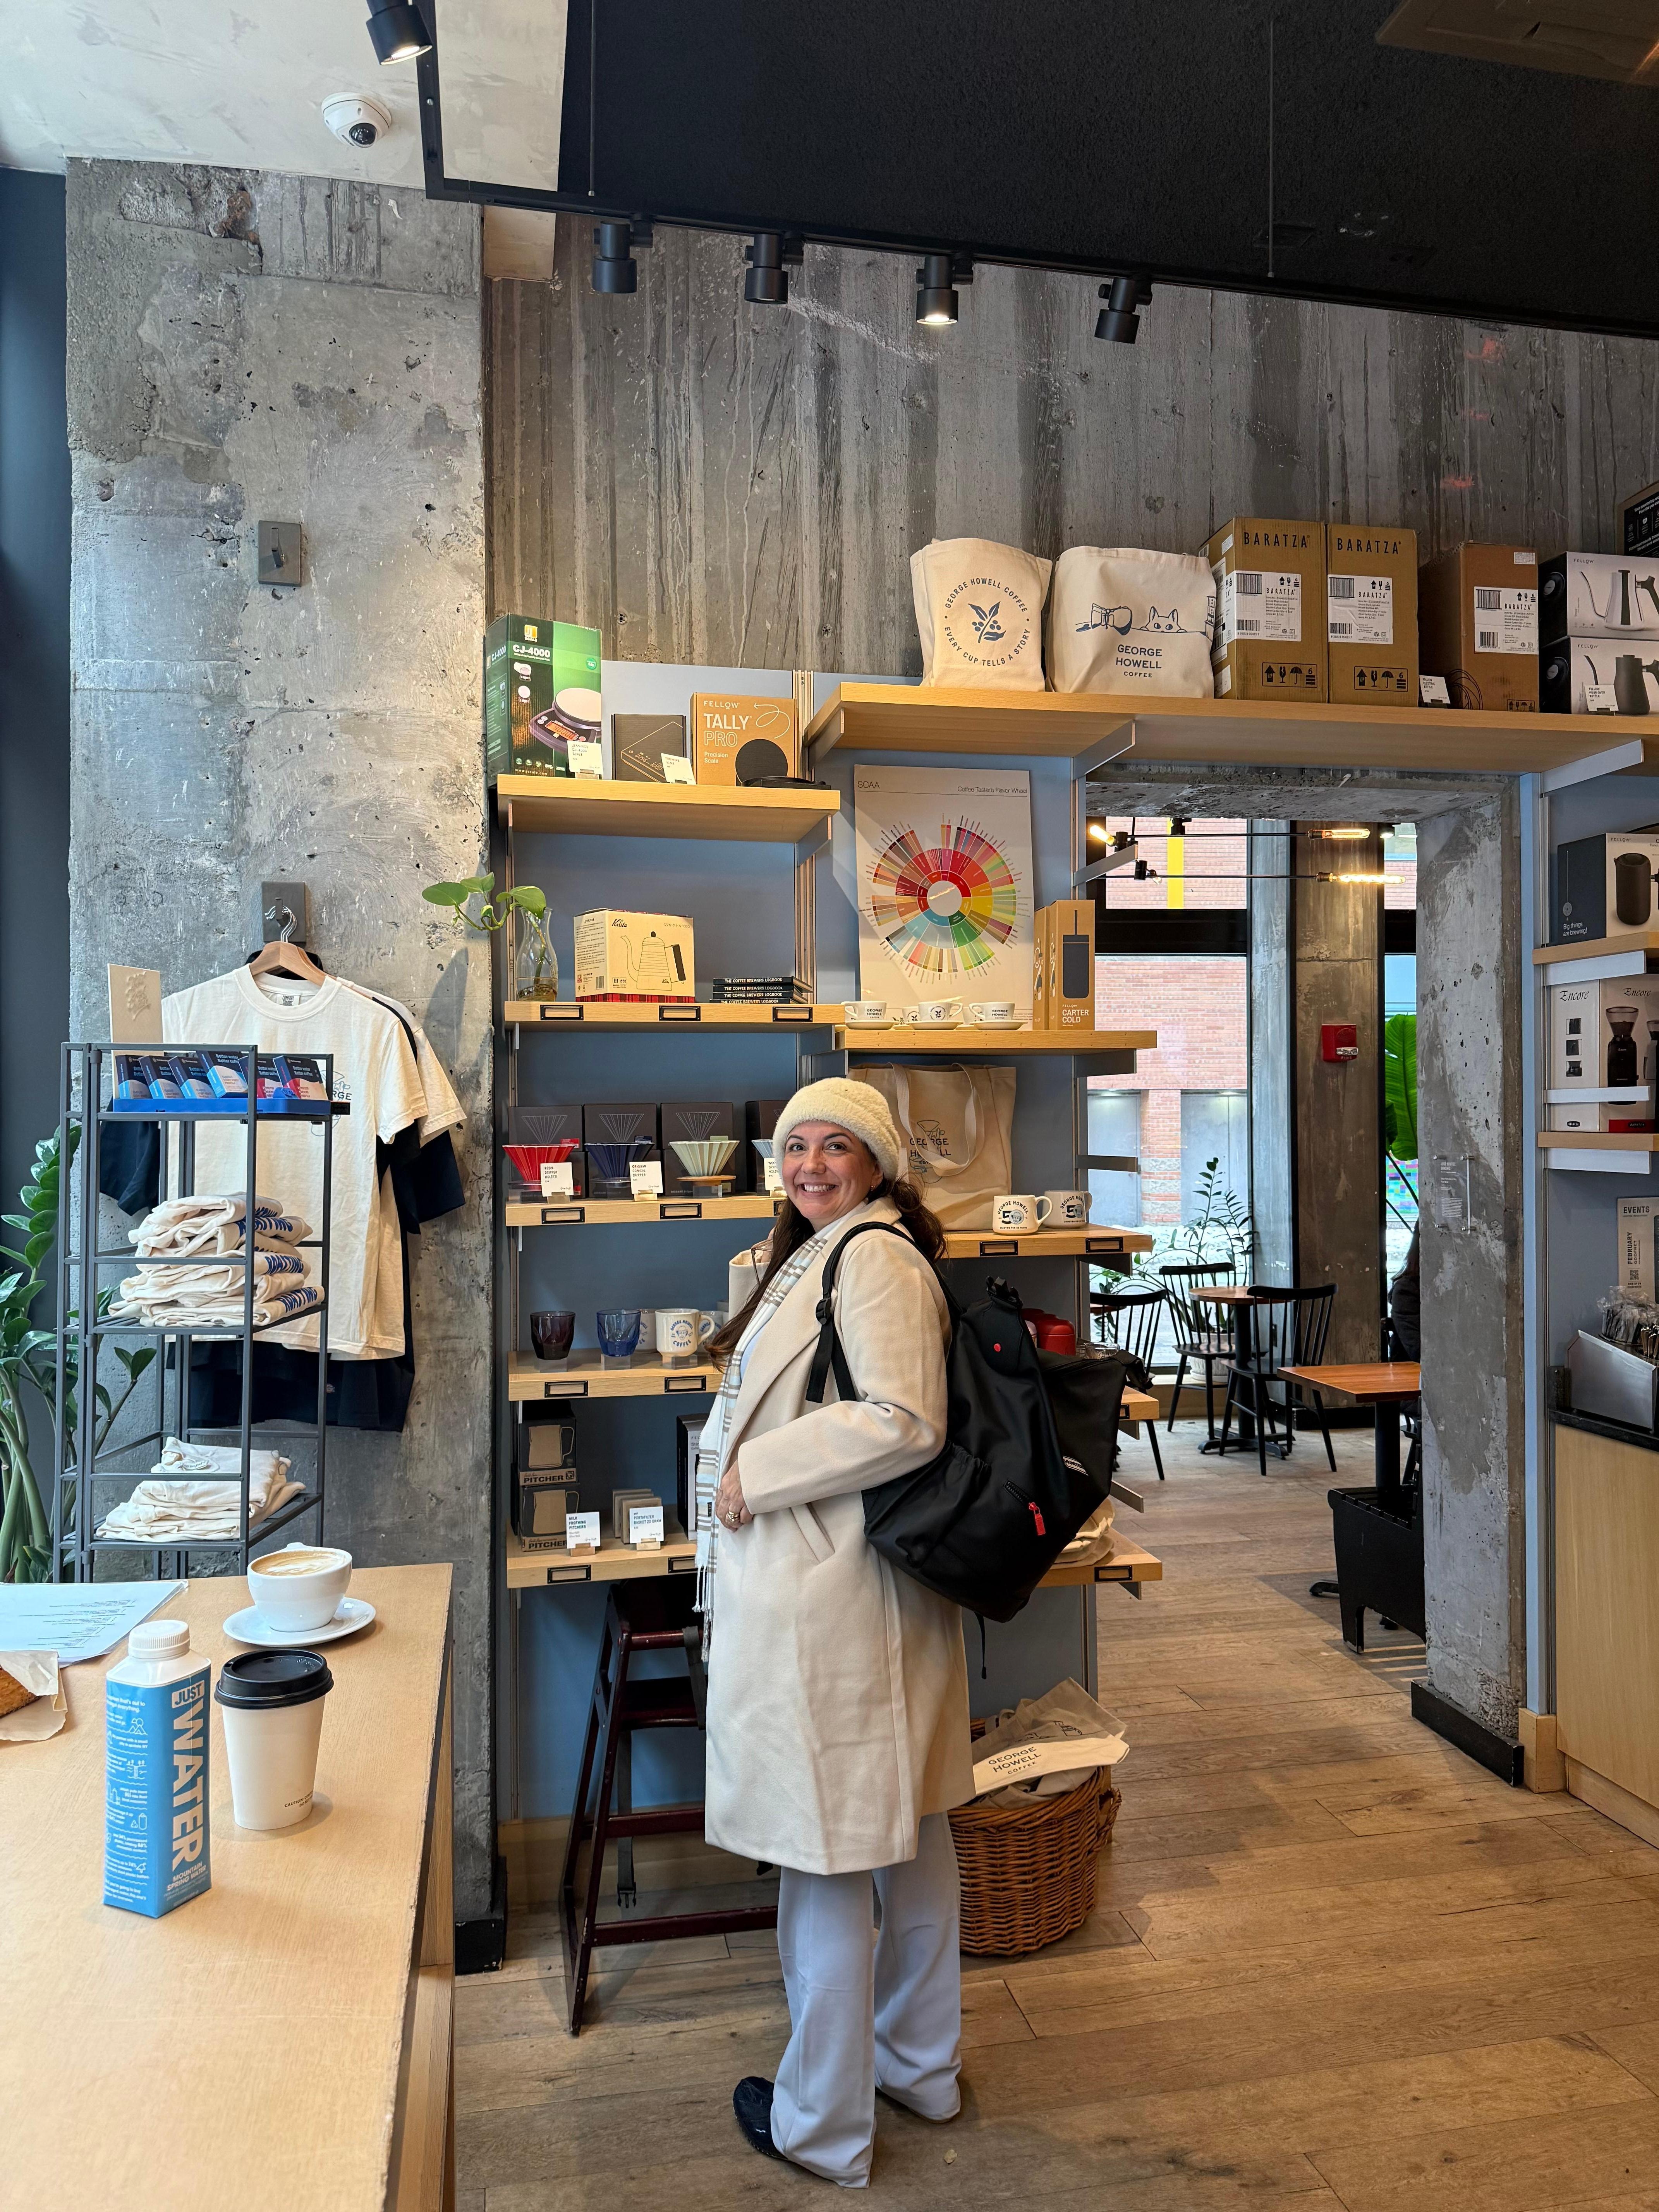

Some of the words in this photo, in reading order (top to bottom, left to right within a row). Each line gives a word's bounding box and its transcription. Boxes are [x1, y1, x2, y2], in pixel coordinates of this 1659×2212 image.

[1244, 532, 1307, 548] BARATZA
[1338, 538, 1398, 554] BARATZA
[945, 581, 968, 608] GEORGE
[971, 578, 1001, 589] HOWELL
[1004, 587, 1028, 612] COFFEE
[491, 646, 506, 661] CJ-4000
[513, 644, 551, 658] CJ-4000
[945, 627, 962, 651] EVERY
[963, 652, 978, 663] CUP
[982, 658, 1005, 666] TELLS
[1014, 629, 1030, 654] STORY
[1118, 644, 1162, 656] GEORGE
[1116, 657, 1161, 668] HOWELL
[704, 701, 738, 709] FELLOW
[704, 713, 749, 730] TALLY
[704, 730, 738, 747] PRO
[612, 919, 627, 927] Kalita
[1559, 991, 1589, 1001] Encore
[1623, 988, 1651, 996] Encore
[332, 1091, 352, 1100] RGE
[998, 1201, 1011, 1214] GEORGE
[1013, 1201, 1029, 1214] HOWELL
[1060, 1196, 1075, 1209] GEORGE
[264, 1255, 304, 1274] ROASTING
[275, 1286, 318, 1313] ROASTING
[670, 1320, 681, 1331] GEORGE
[682, 1320, 694, 1330] HOWELL
[175, 1683, 201, 1705] JUST
[989, 1747, 1037, 1764] GEORGE
[993, 1754, 1041, 1772] HOWELL
[1008, 1761, 1037, 1774] COFFEE
[172, 1698, 204, 1872] WATER
[167, 1876, 189, 1891] SPRING
[191, 1865, 206, 1879] WATER
[173, 1862, 203, 1882] MOUNTAIN
